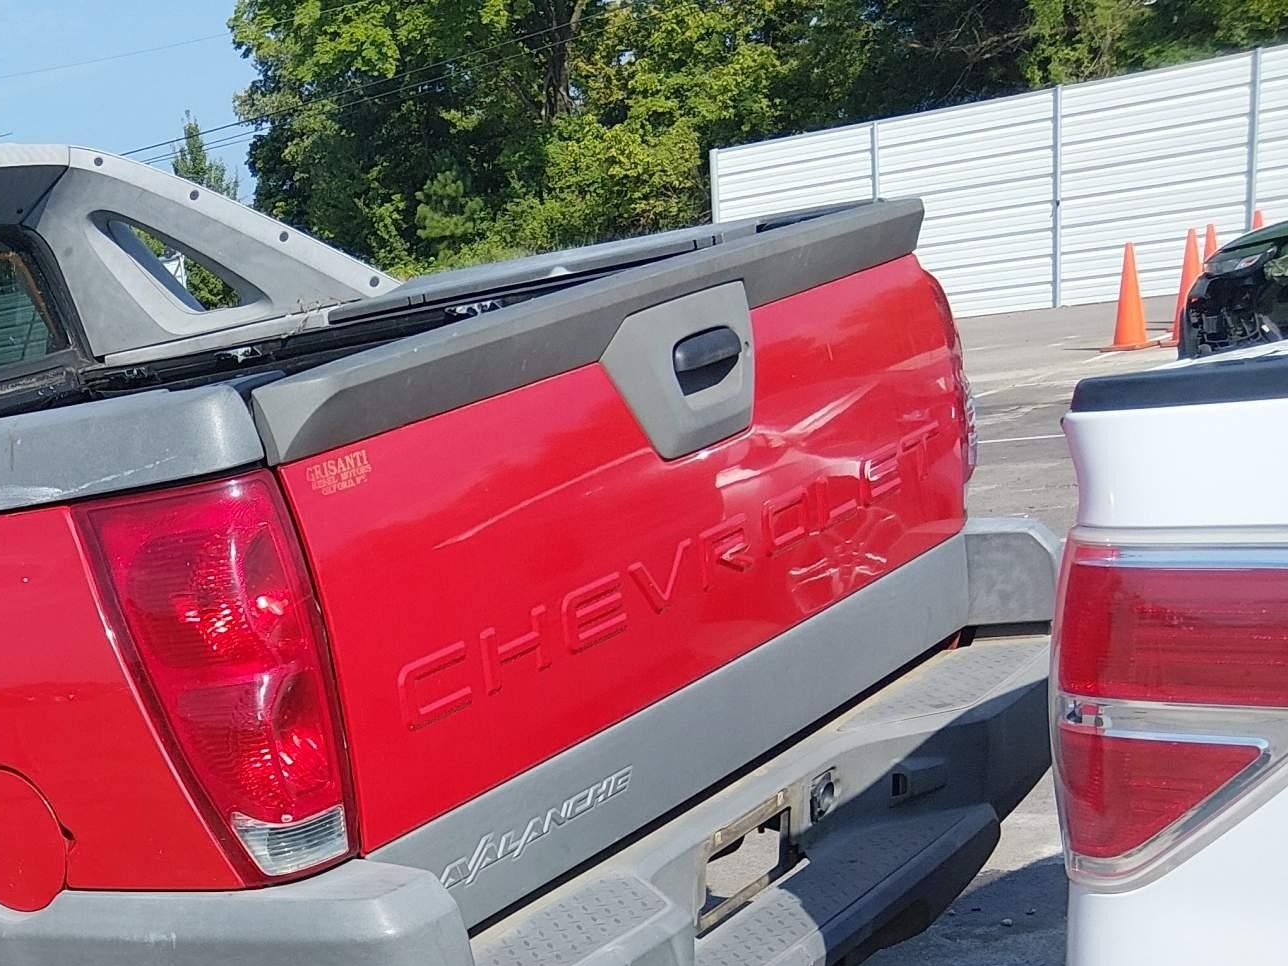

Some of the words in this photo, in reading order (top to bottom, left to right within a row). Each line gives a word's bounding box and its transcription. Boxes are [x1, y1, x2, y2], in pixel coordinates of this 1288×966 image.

[306, 449, 369, 482] GRISANTI
[397, 420, 940, 731] CHEVROLET
[439, 764, 632, 889] AVALANCHE
